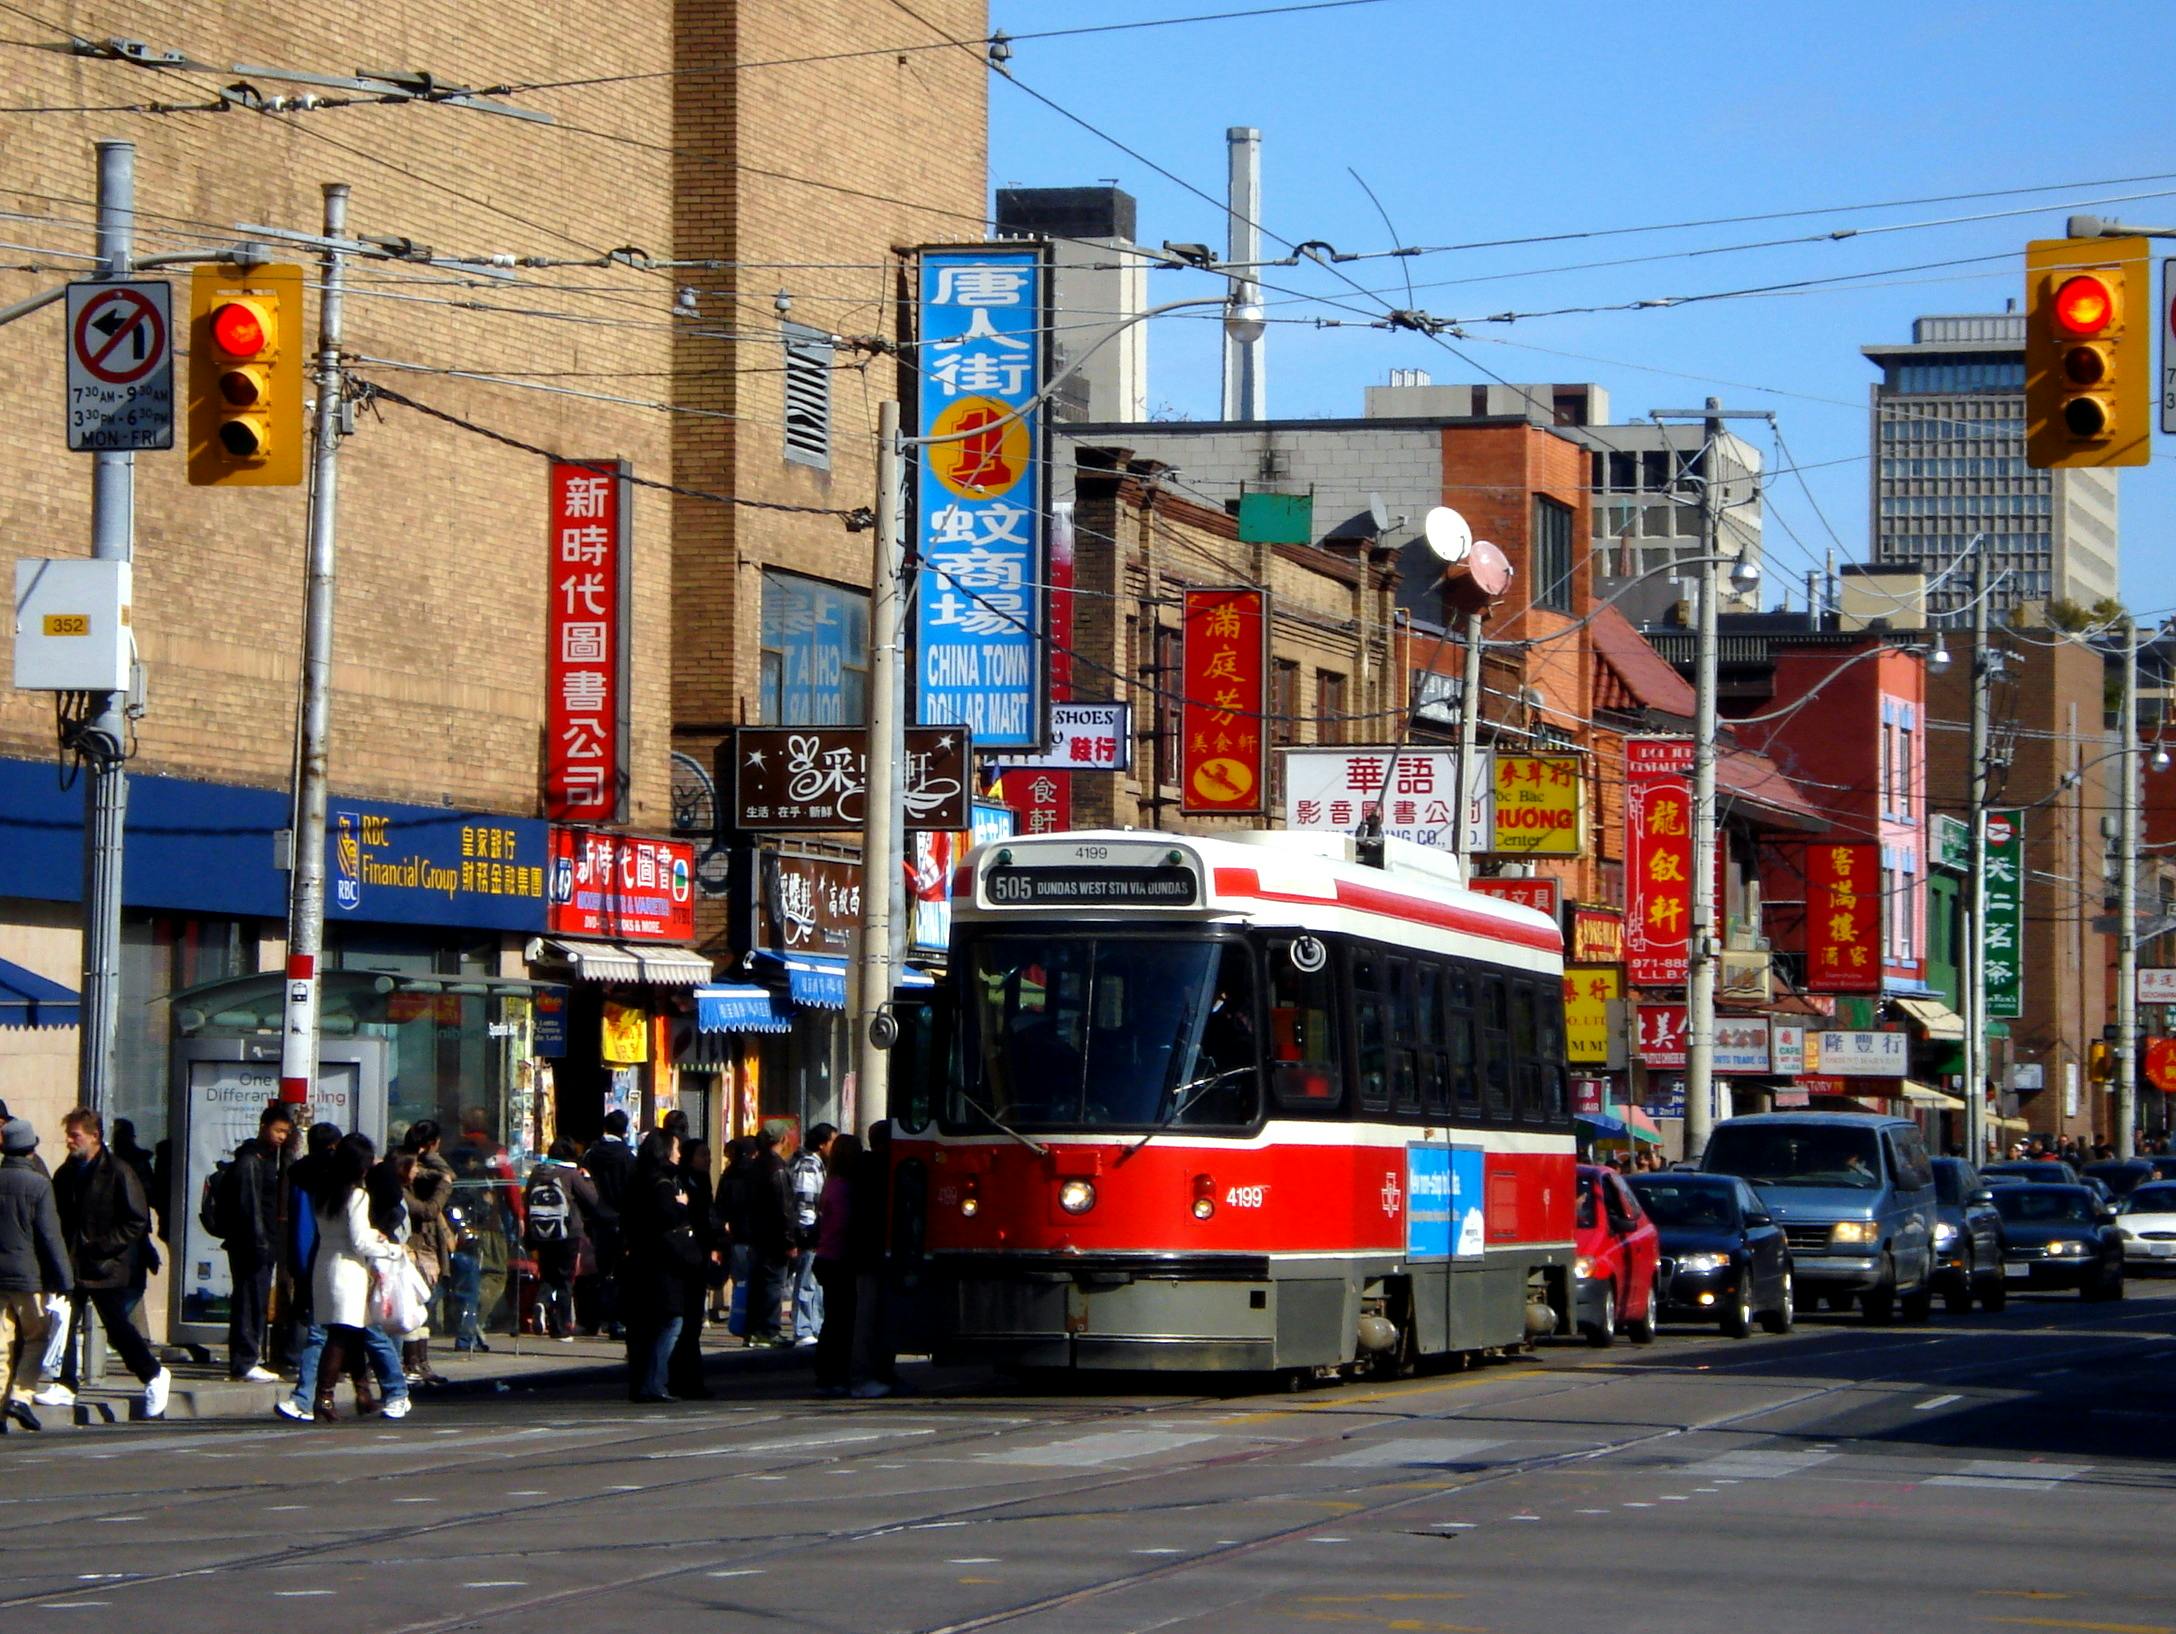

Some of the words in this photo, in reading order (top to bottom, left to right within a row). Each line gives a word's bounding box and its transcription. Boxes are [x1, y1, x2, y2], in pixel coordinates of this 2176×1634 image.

[930, 262, 1031, 395] 唐人街
[928, 504, 1030, 636] 蚊商場
[53, 618, 83, 632] 352
[560, 477, 609, 806] 新時代圖書公司
[927, 645, 979, 687] CHINA
[983, 645, 1029, 686] TOWN
[1203, 602, 1247, 726] 滿庭芳
[927, 692, 984, 735] DOLLAR
[989, 693, 1029, 734] MART
[1055, 709, 1114, 725] SHOES
[1069, 737, 1117, 762] 鞋行
[1346, 757, 1436, 795] 華語
[362, 815, 390, 847] RBC
[462, 825, 517, 861] 皇家銀行
[1075, 847, 1107, 859] 4199
[337, 879, 357, 901] RBC
[362, 854, 419, 888] Financial
[421, 860, 458, 900] Group
[996, 876, 1032, 899] 505
[1037, 882, 1077, 895] DUNDAS
[1080, 882, 1106, 895] WEST
[1109, 882, 1128, 895] STN
[1130, 882, 1146, 895] VIA
[1147, 882, 1188, 895] DUNDAS
[239, 1072, 272, 1087] One
[1226, 1185, 1263, 1208] 4199
